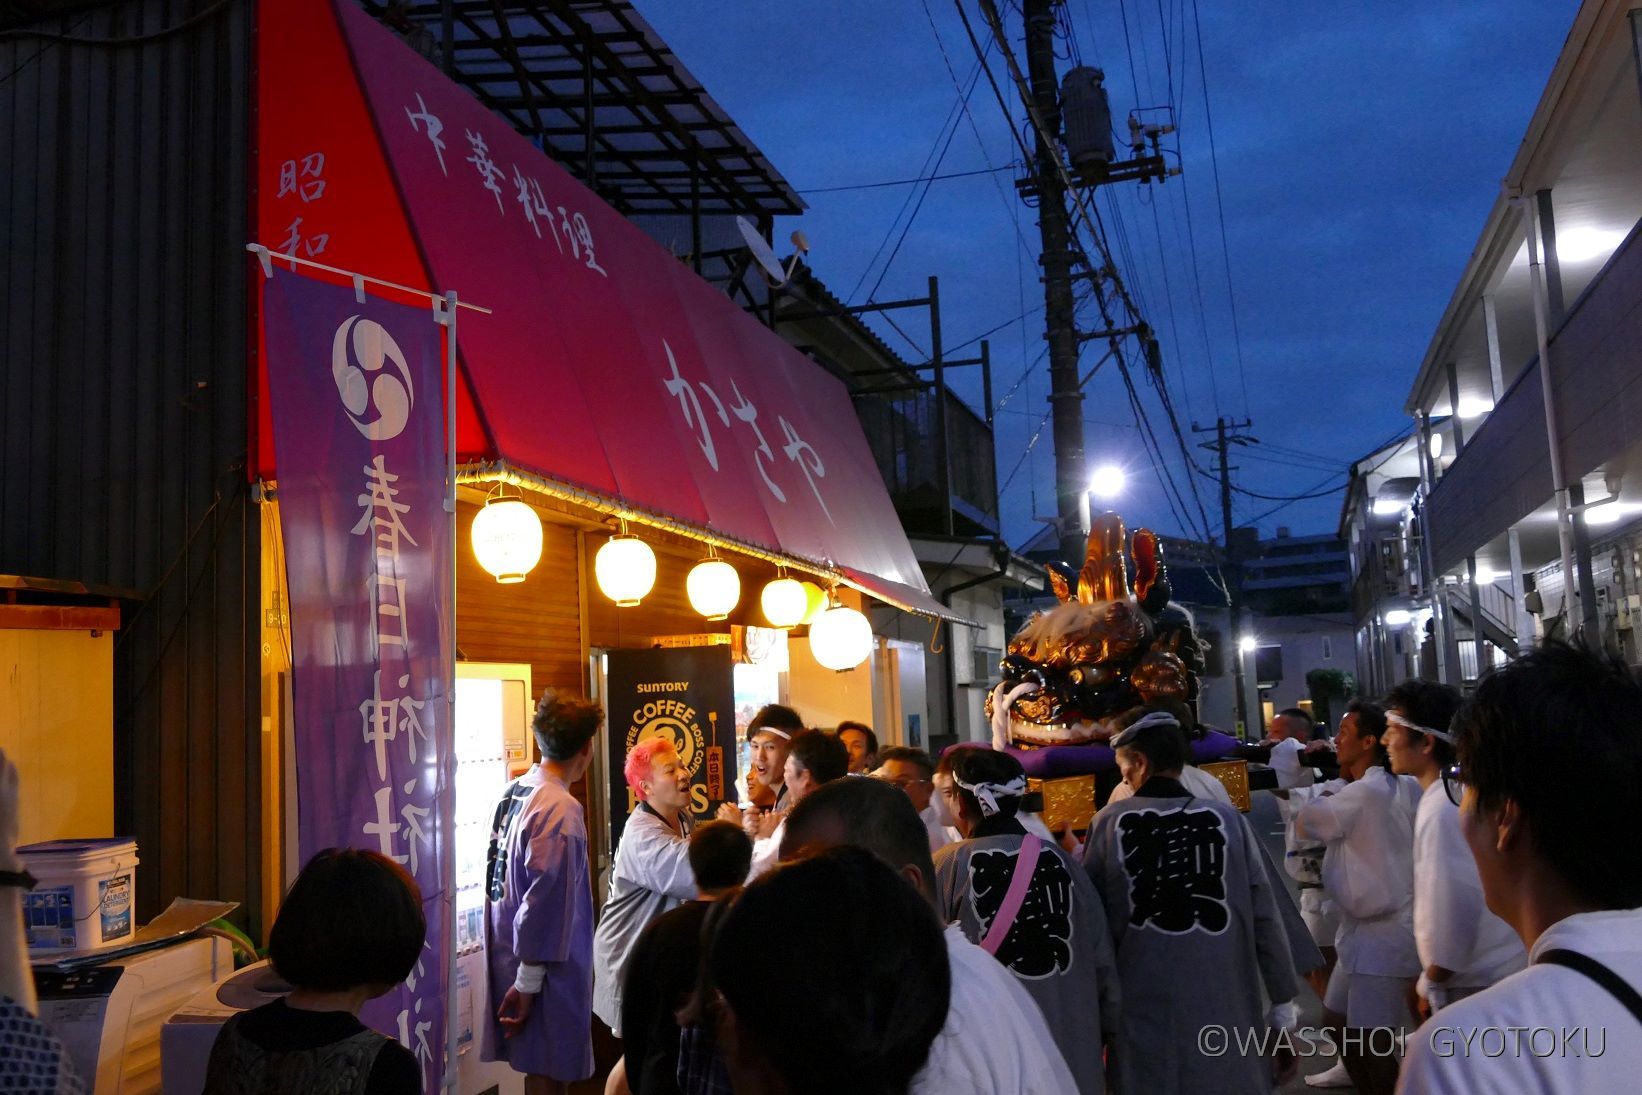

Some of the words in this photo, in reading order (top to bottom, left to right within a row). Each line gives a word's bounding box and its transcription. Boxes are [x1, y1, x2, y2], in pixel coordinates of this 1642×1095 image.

[277, 152, 330, 272] 昭和
[637, 682, 689, 693] SUNTORY
[633, 700, 696, 725] COFFEE
[626, 725, 639, 754] OFFEE
[690, 723, 705, 748] BOSS
[689, 750, 704, 778] COFF
